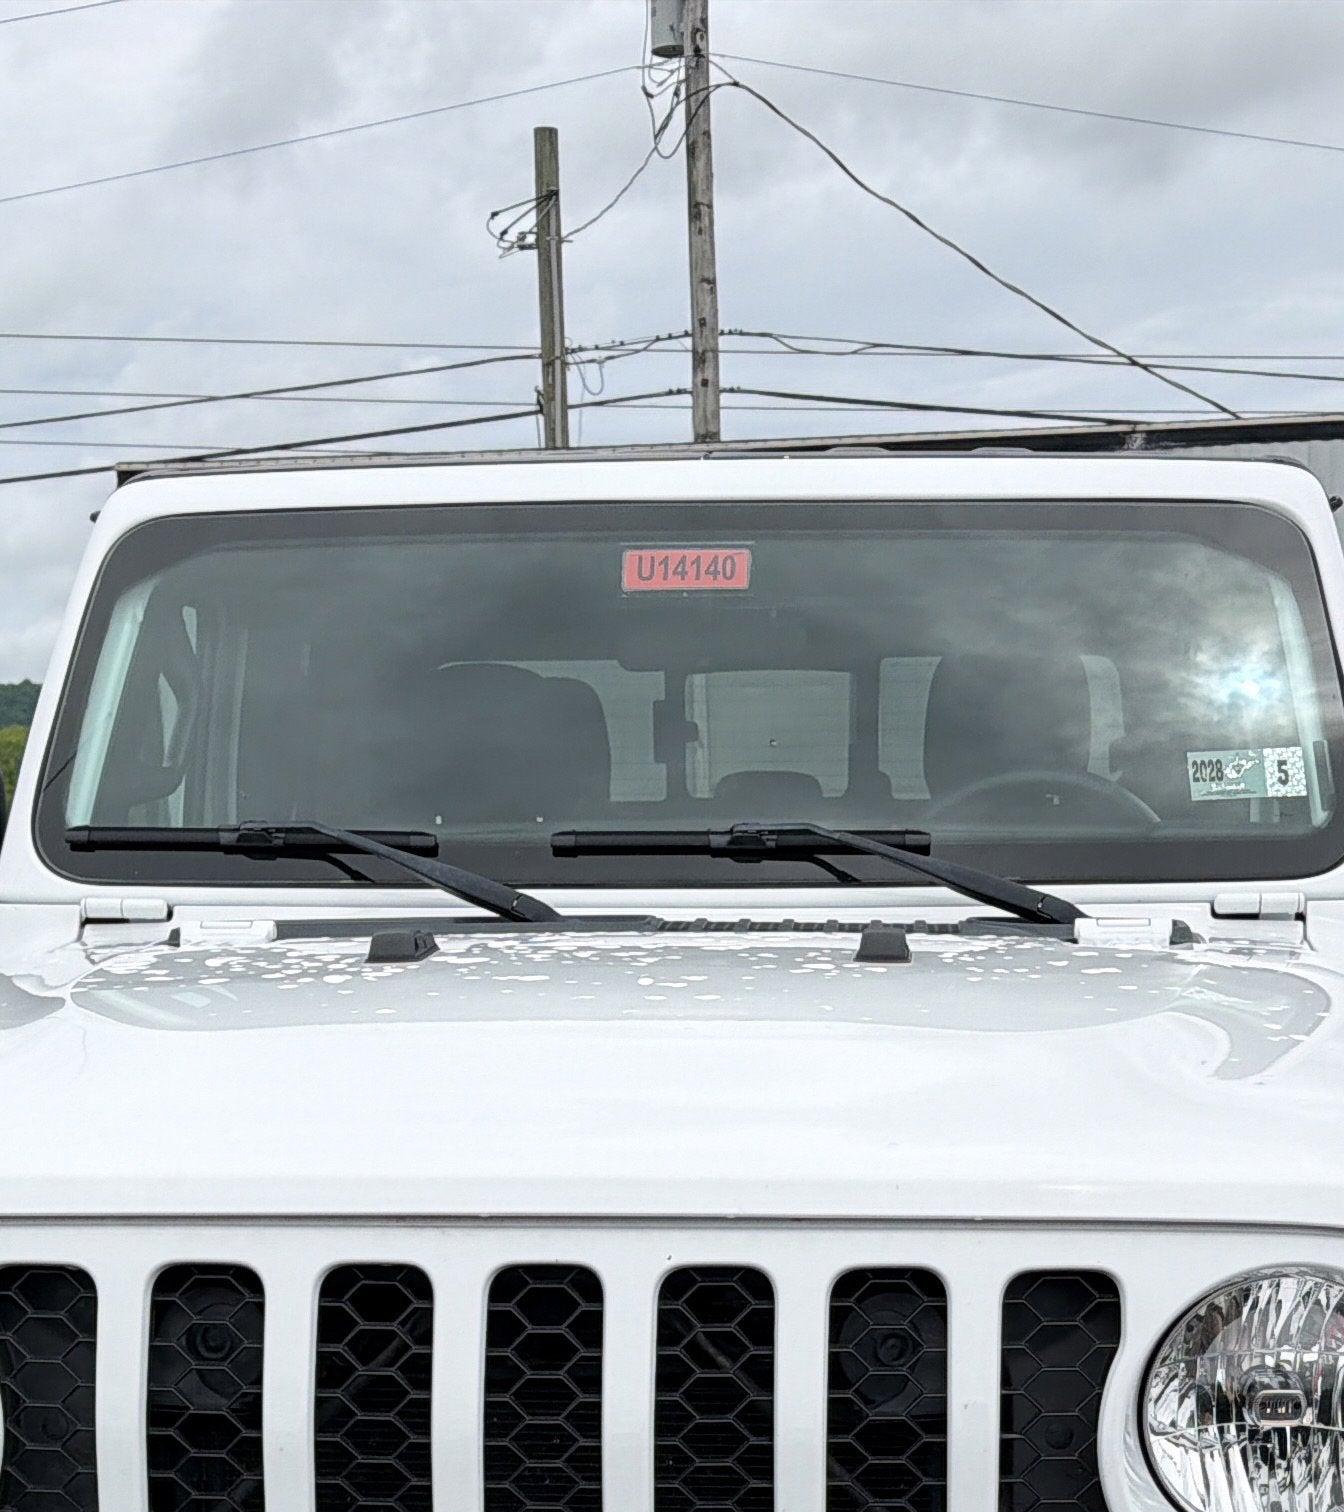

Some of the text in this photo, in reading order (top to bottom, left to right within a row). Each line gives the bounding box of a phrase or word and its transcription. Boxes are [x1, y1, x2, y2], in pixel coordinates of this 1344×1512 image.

[636, 554, 737, 582] U14140
[1191, 758, 1224, 783] 2028
[1276, 759, 1290, 786] 5
